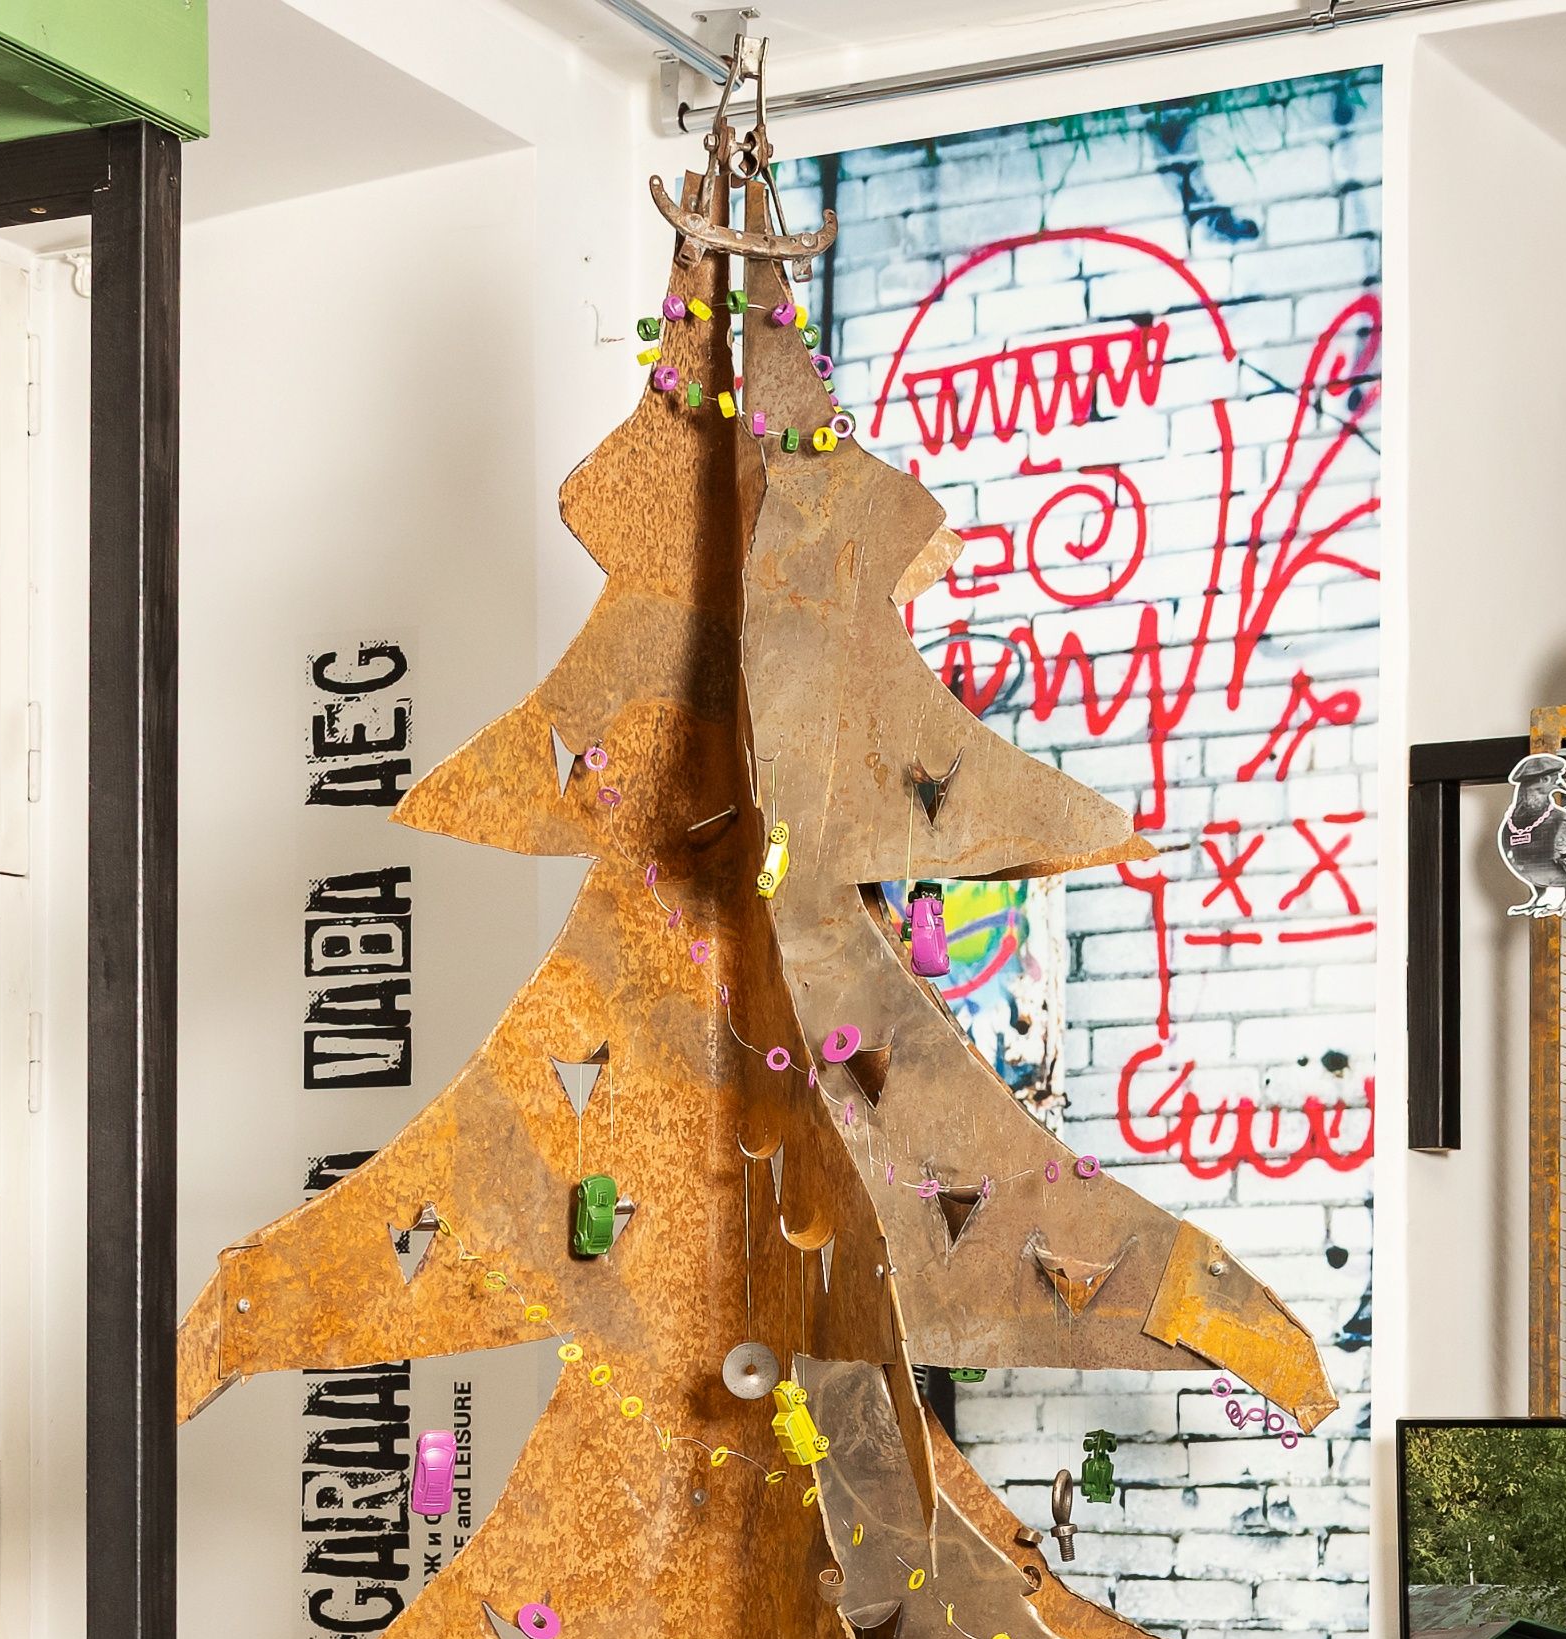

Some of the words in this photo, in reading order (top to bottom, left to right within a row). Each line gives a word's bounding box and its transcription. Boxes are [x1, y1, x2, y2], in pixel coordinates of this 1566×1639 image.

[306, 640, 412, 807] AEG
[303, 866, 411, 1089] VABA
[302, 1360, 410, 1638] GARAA
[453, 1380, 472, 1481] LEISURE
[453, 1485, 472, 1528] and
